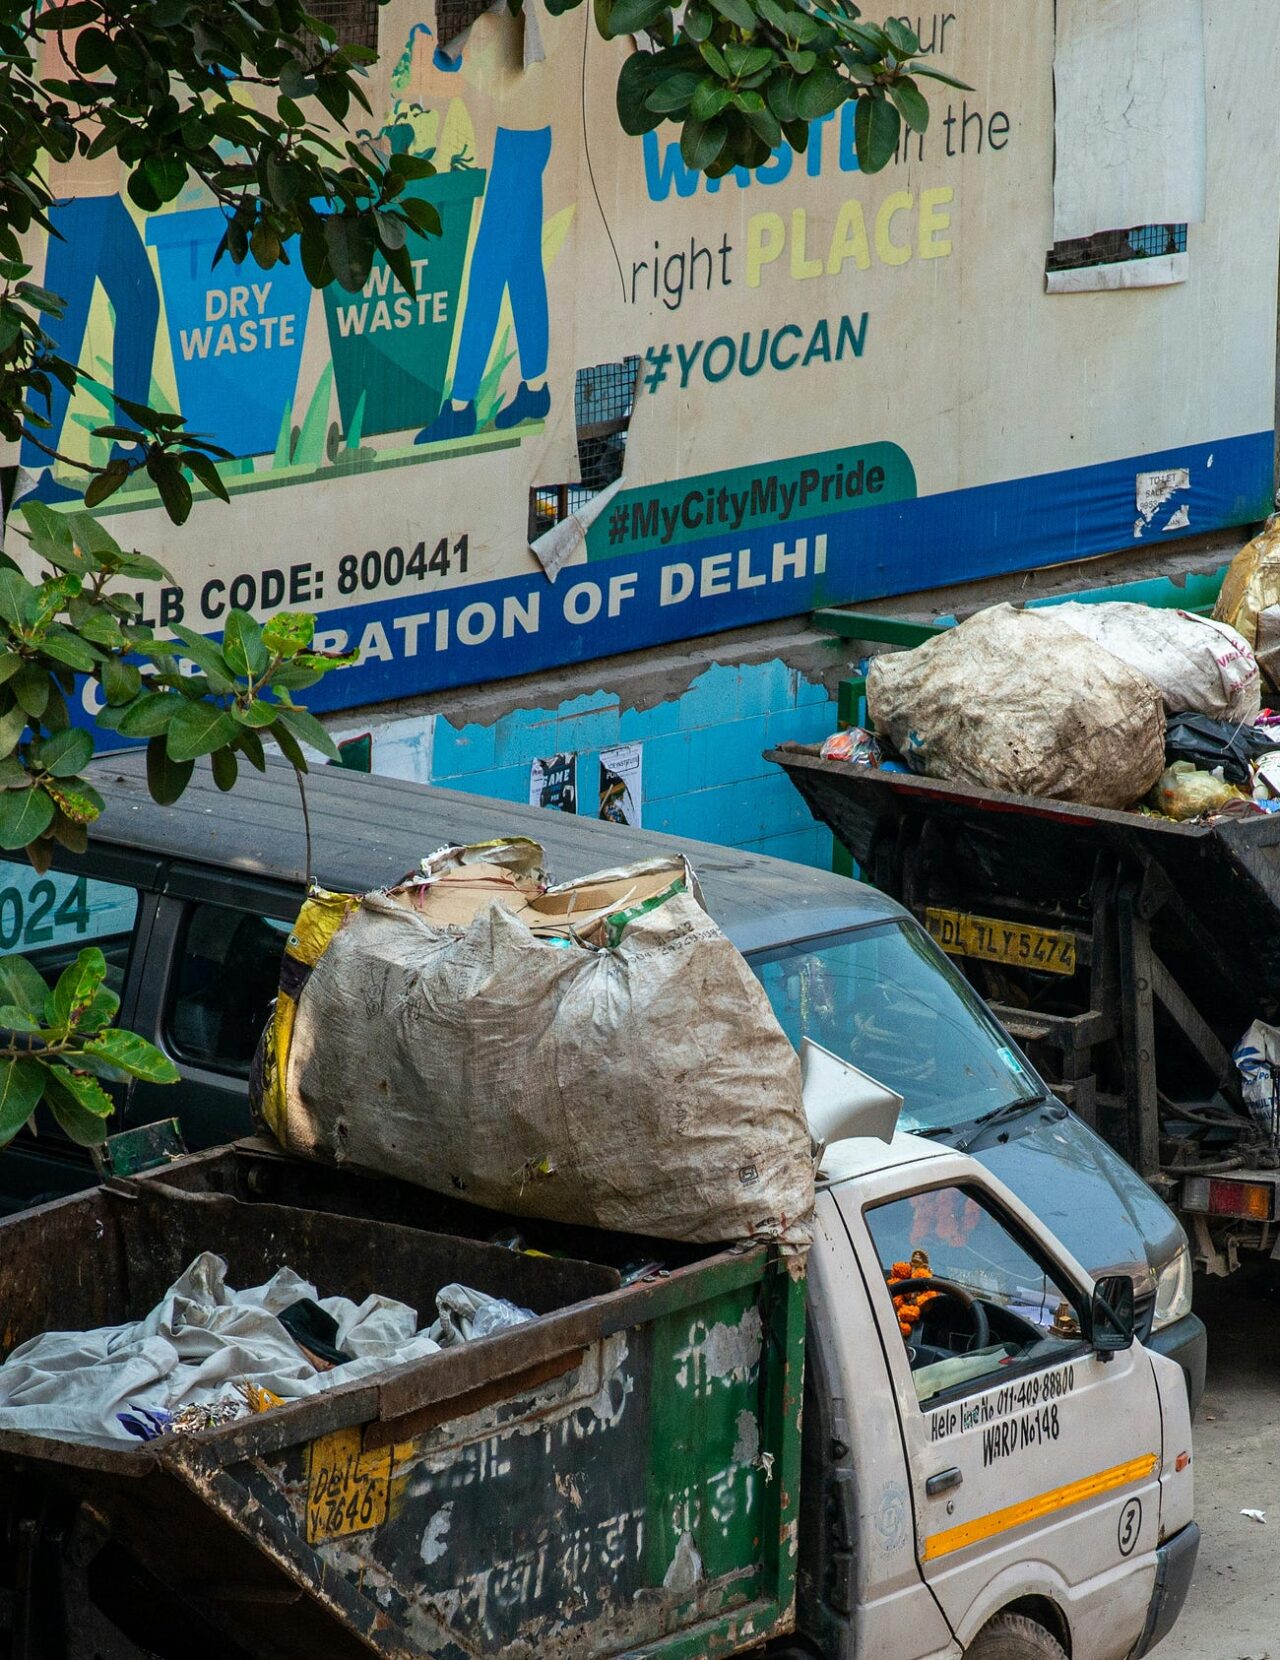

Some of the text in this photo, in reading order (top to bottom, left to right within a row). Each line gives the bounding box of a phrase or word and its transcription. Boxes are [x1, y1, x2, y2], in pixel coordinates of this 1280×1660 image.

[943, 100, 1010, 156] the
[631, 186, 955, 311] right PLACE
[205, 282, 272, 322] DRY
[362, 258, 428, 298] WET
[179, 313, 296, 361] WASTE
[336, 291, 448, 337] WASTE
[644, 312, 869, 394] #YOUCAN
[608, 458, 886, 545] #MyCityMyPride
[120, 534, 470, 629] LB CODE: 800441
[562, 571, 637, 625] OF
[659, 533, 829, 607] DELHI
[931, 1409, 957, 1442] Help
[960, 1401, 980, 1434] line
[983, 1418, 1018, 1467] WARD
[1121, 1507, 1138, 1545] 3
